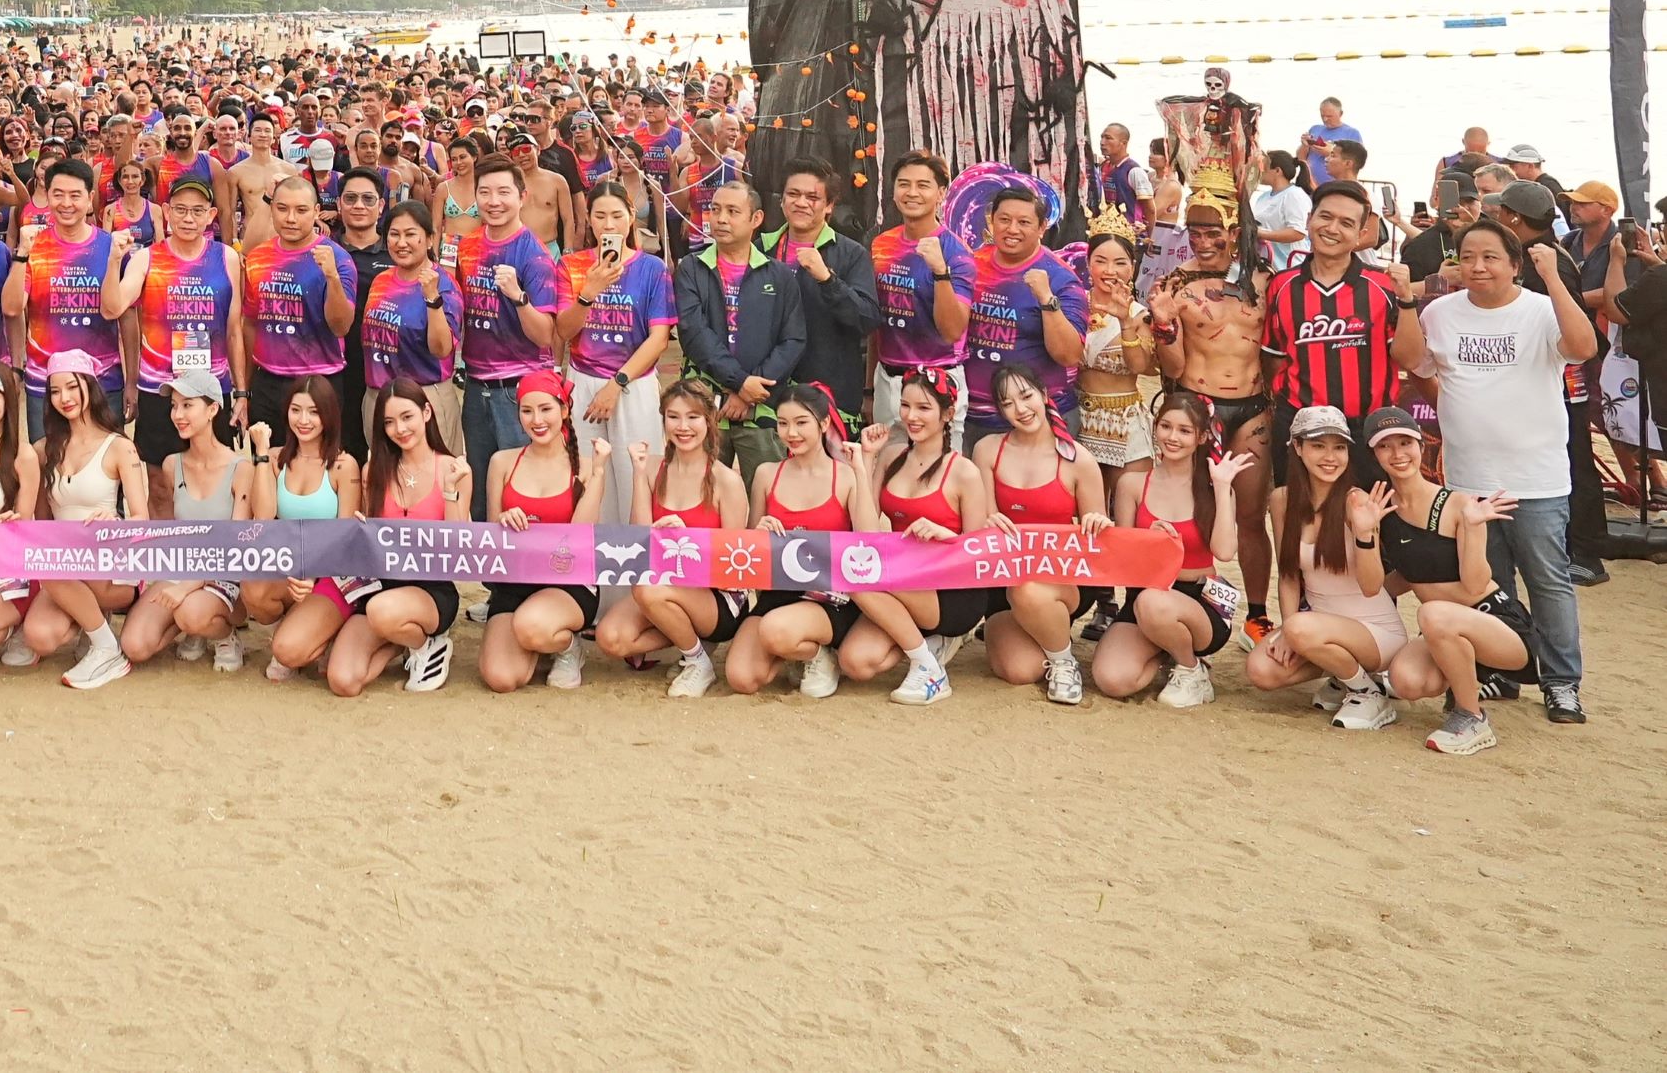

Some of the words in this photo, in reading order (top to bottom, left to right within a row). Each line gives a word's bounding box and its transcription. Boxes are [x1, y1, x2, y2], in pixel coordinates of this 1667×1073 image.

[49, 276, 100, 287] PATTAYA
[878, 272, 914, 289] PATTAYA
[167, 285, 214, 295] PATTAYA
[259, 281, 302, 296] PATTAYA
[595, 293, 633, 305] ATTAYA
[981, 291, 1008, 301] CENTRAL
[981, 296, 1006, 305] PATTAYA
[591, 302, 632, 311] TERNATIONAL
[971, 301, 1017, 321] ATTAYA
[978, 336, 995, 347] RACE
[995, 339, 1014, 350] 2026
[176, 354, 207, 365] 8253
[1458, 352, 1515, 363] GIRBAUD
[1434, 490, 1447, 508] PRO
[95, 530, 109, 542] 10
[111, 527, 145, 540] YEARS
[144, 525, 213, 538] ANNIVERSARY
[377, 526, 516, 550] CENTRAL
[964, 531, 1101, 557] CENTRAL
[24, 547, 95, 562] PATTAYA
[186, 547, 225, 558] BEACH
[227, 546, 294, 572] 2026
[24, 562, 96, 572] INTERNATIONAL
[186, 558, 226, 572] RACE
[385, 552, 508, 575] PATTAYA
[975, 554, 1092, 580] PATTAYA
[1209, 583, 1237, 604] 8622
